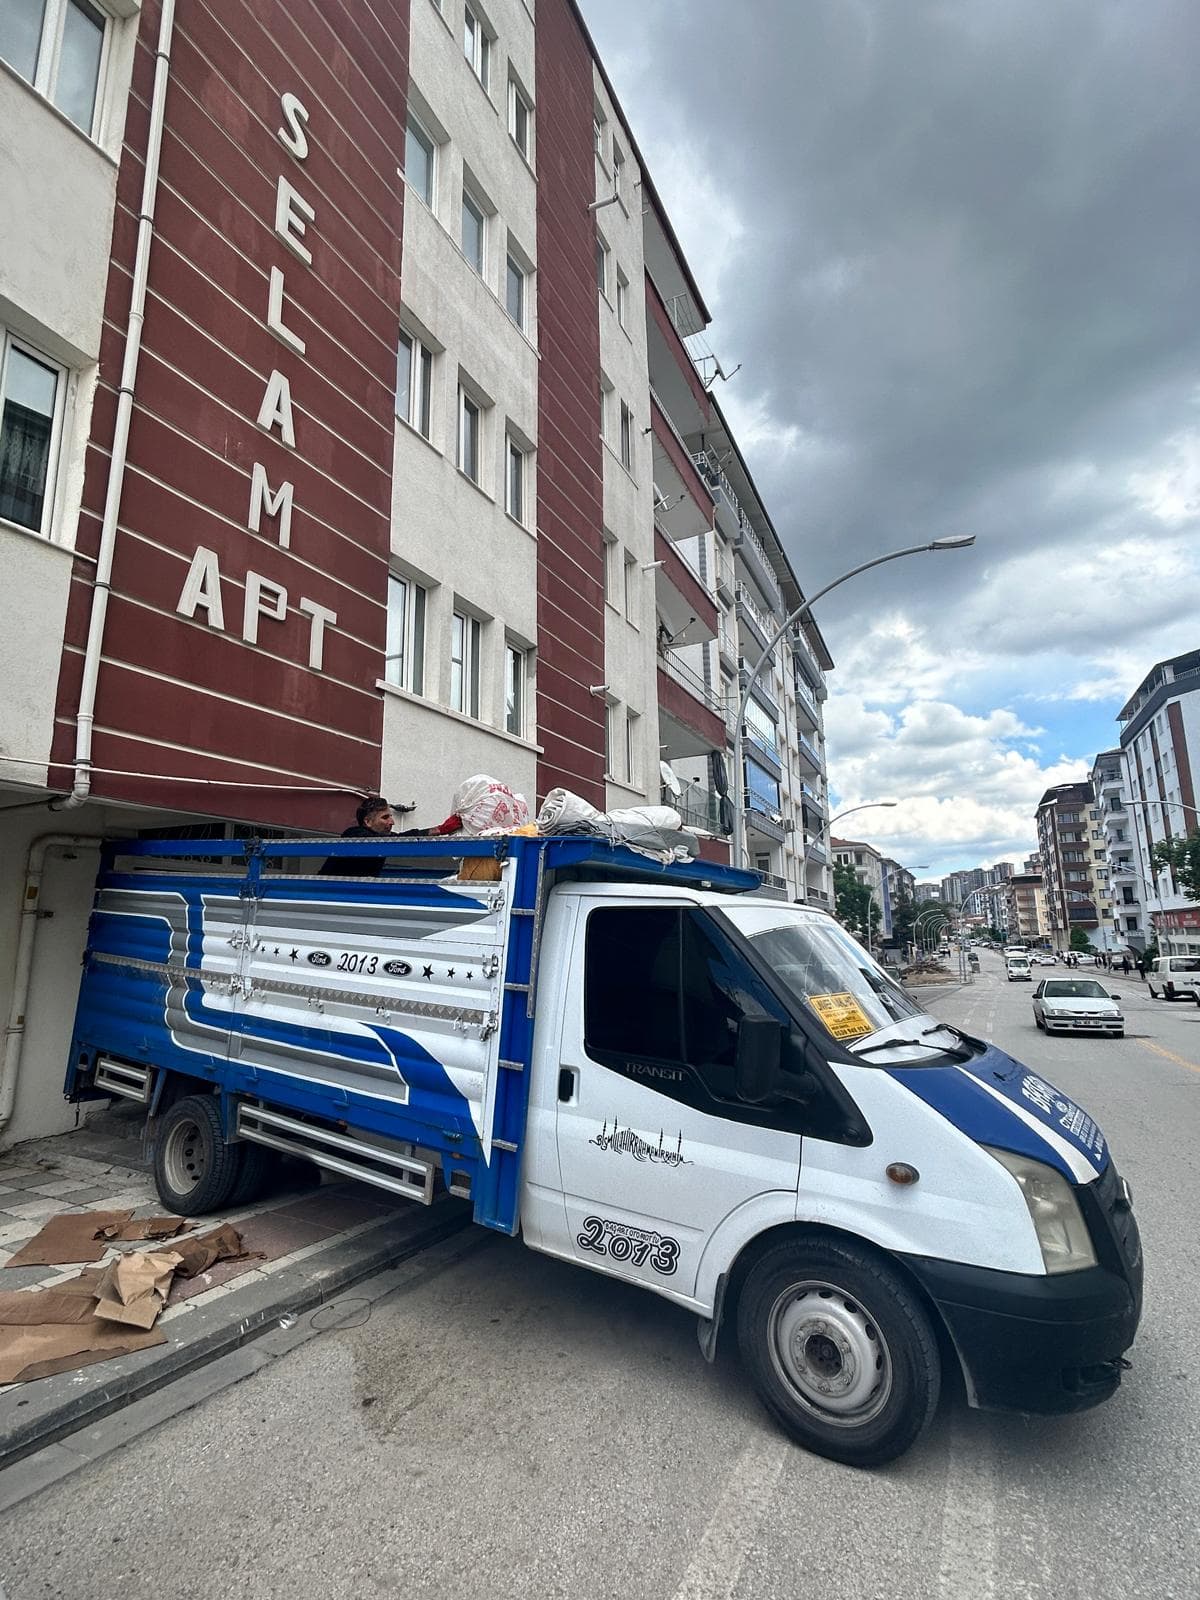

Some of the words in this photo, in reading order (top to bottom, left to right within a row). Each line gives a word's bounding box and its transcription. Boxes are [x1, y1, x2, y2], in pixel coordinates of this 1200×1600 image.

[247, 92, 316, 550] SELAM
[175, 545, 337, 671] APT
[336, 952, 379, 975] 2013
[624, 1062, 684, 1081] TRANSIT
[577, 1216, 680, 1276] 2013
